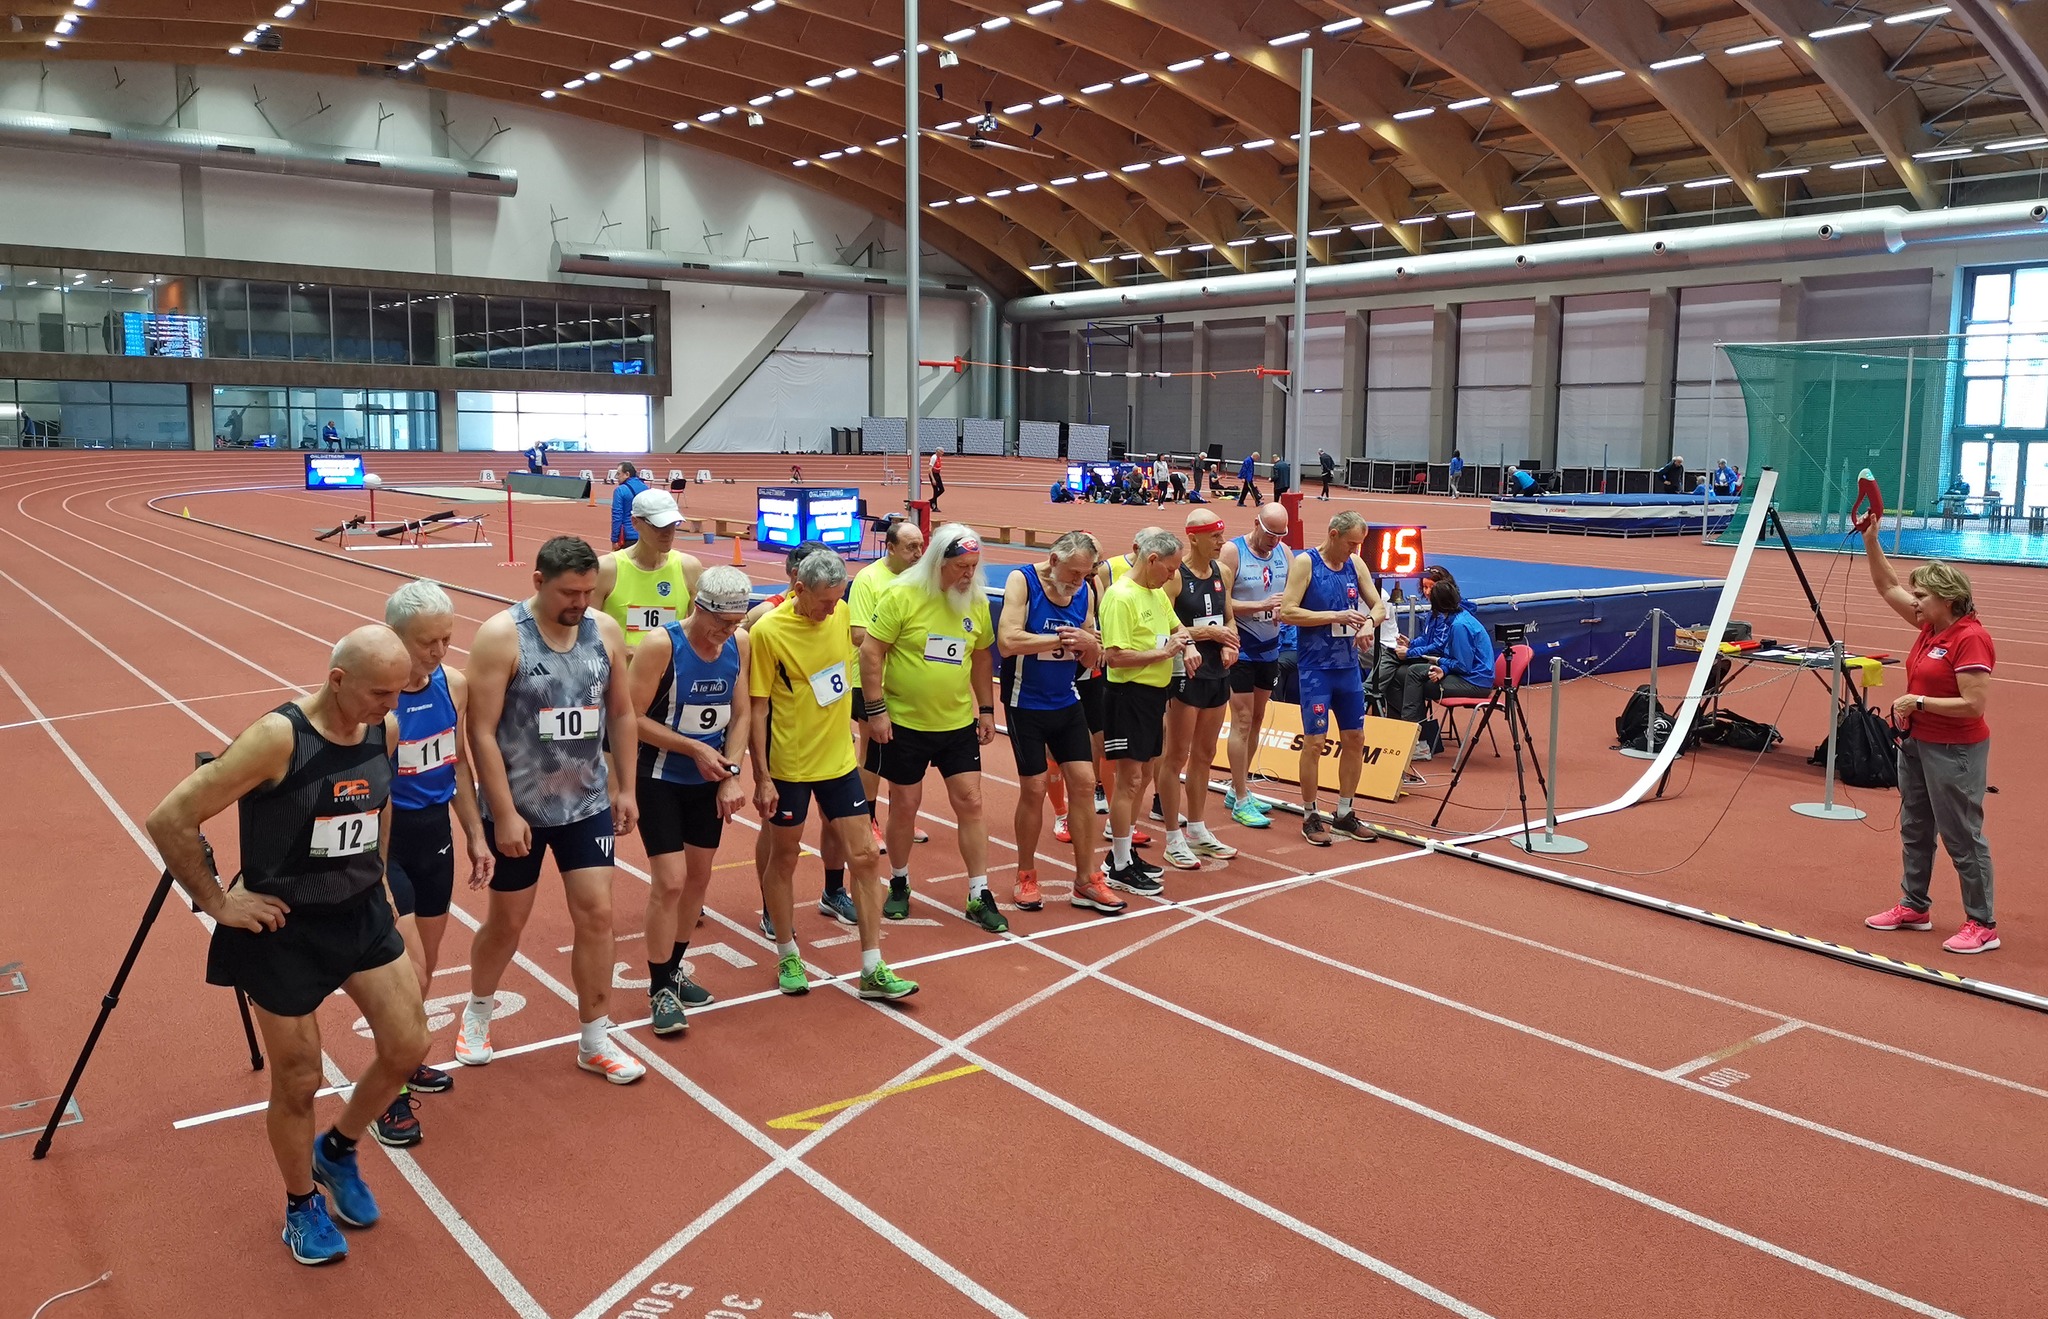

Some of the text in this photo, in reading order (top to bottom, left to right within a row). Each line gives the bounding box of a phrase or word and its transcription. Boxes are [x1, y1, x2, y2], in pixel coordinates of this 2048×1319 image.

[1380, 528, 1418, 573] 15
[643, 609, 660, 627] 16
[946, 643, 957, 657] 6
[830, 673, 844, 694] 8
[555, 710, 582, 736] 10
[421, 738, 441, 766] 11
[333, 795, 370, 803] RUMBURK
[337, 818, 363, 851] 12
